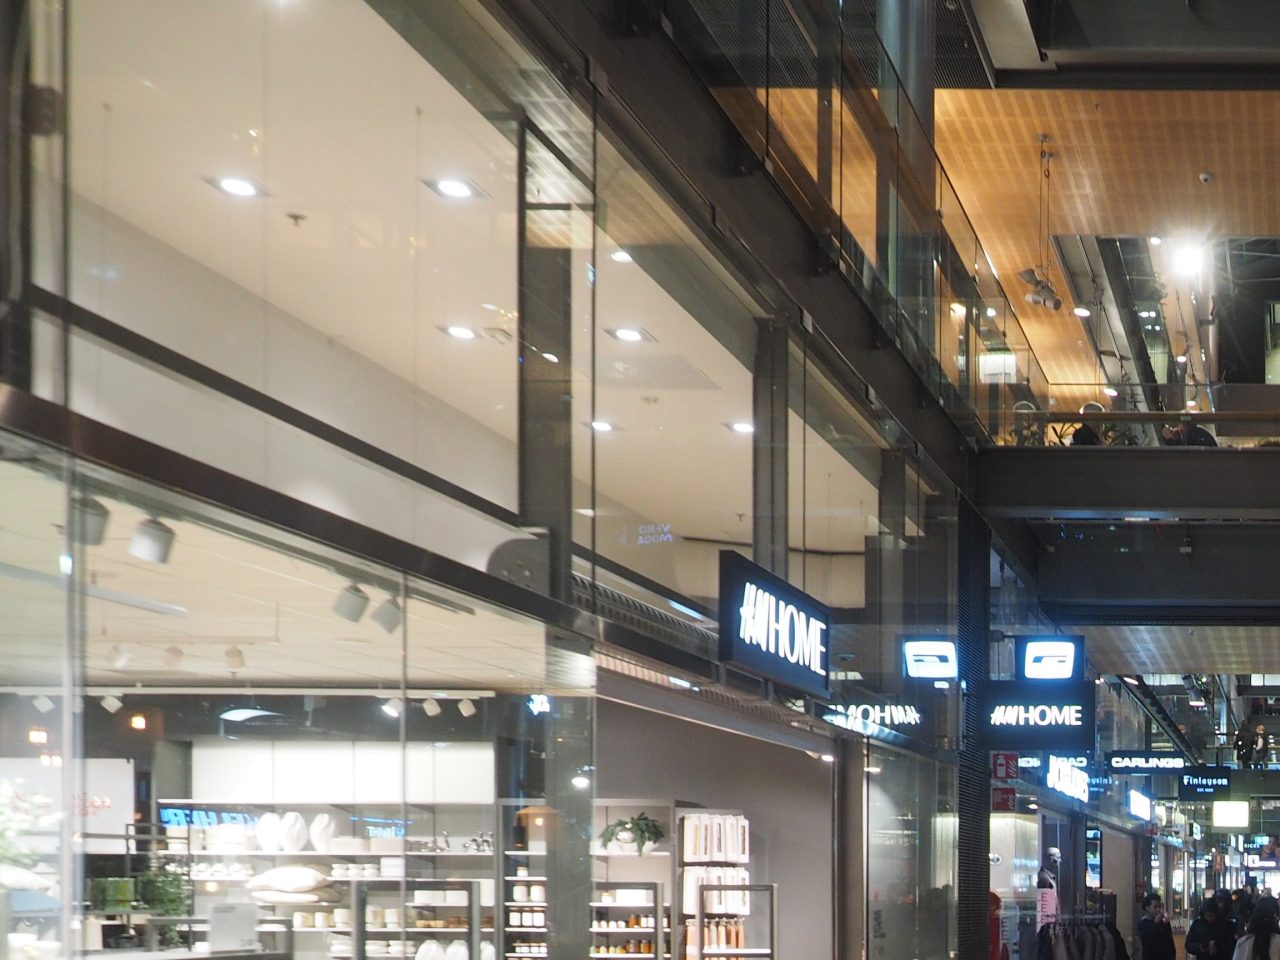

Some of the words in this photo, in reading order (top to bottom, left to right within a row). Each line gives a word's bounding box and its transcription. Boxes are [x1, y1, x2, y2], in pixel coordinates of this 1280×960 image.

[769, 595, 826, 675] HOME
[1018, 705, 1082, 725] HOME
[1111, 757, 1184, 768] CARLINGS
[1183, 775, 1228, 786] Finlayson
